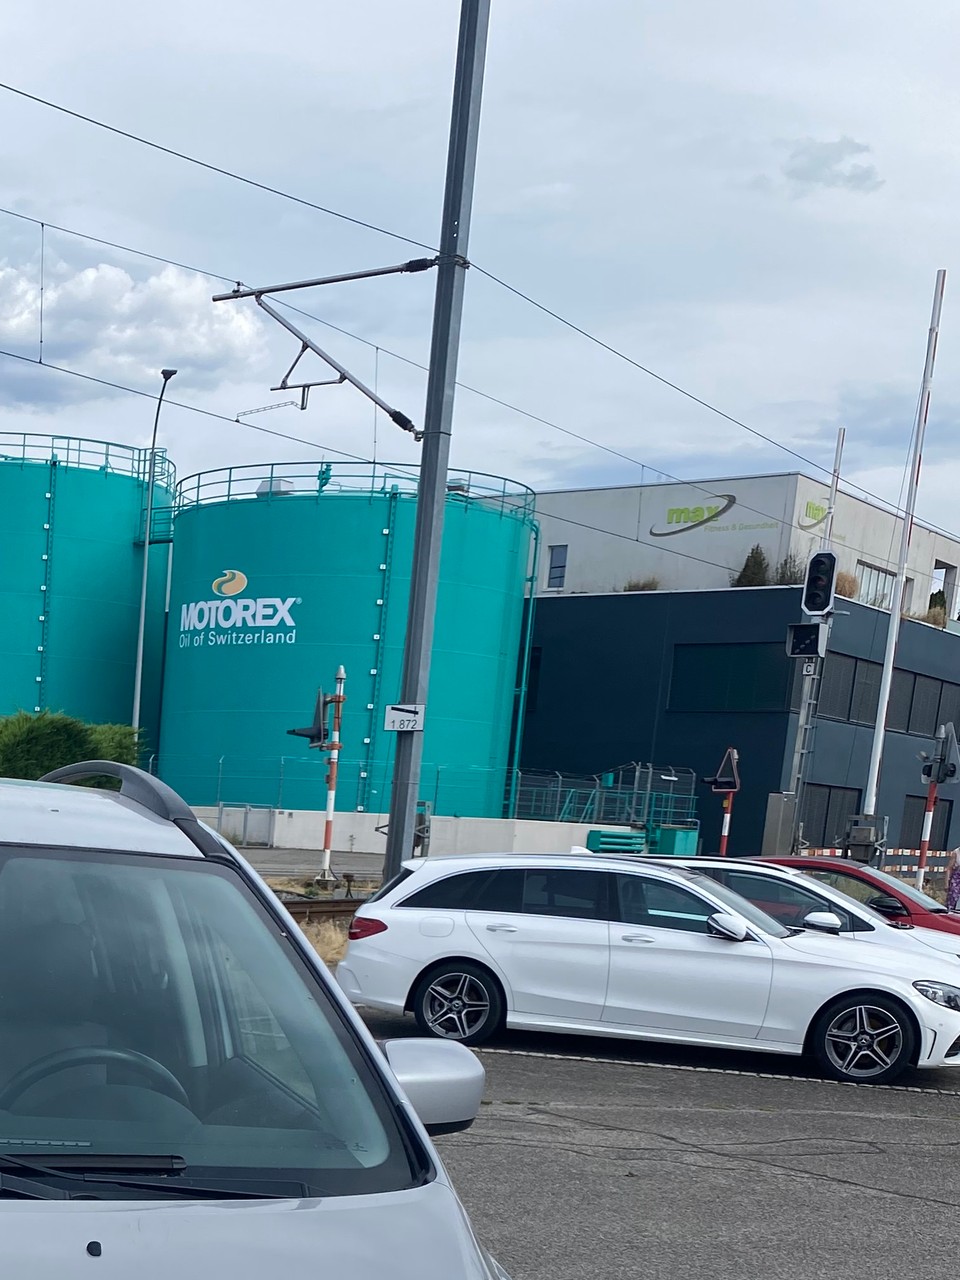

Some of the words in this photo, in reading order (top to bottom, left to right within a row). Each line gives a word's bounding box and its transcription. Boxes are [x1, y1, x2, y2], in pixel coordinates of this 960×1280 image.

[180, 597, 297, 632] MOTOREX
[179, 633, 191, 648] Oil
[193, 631, 205, 647] of
[208, 629, 296, 646] Switzerland
[391, 719, 417, 730] 1.872
